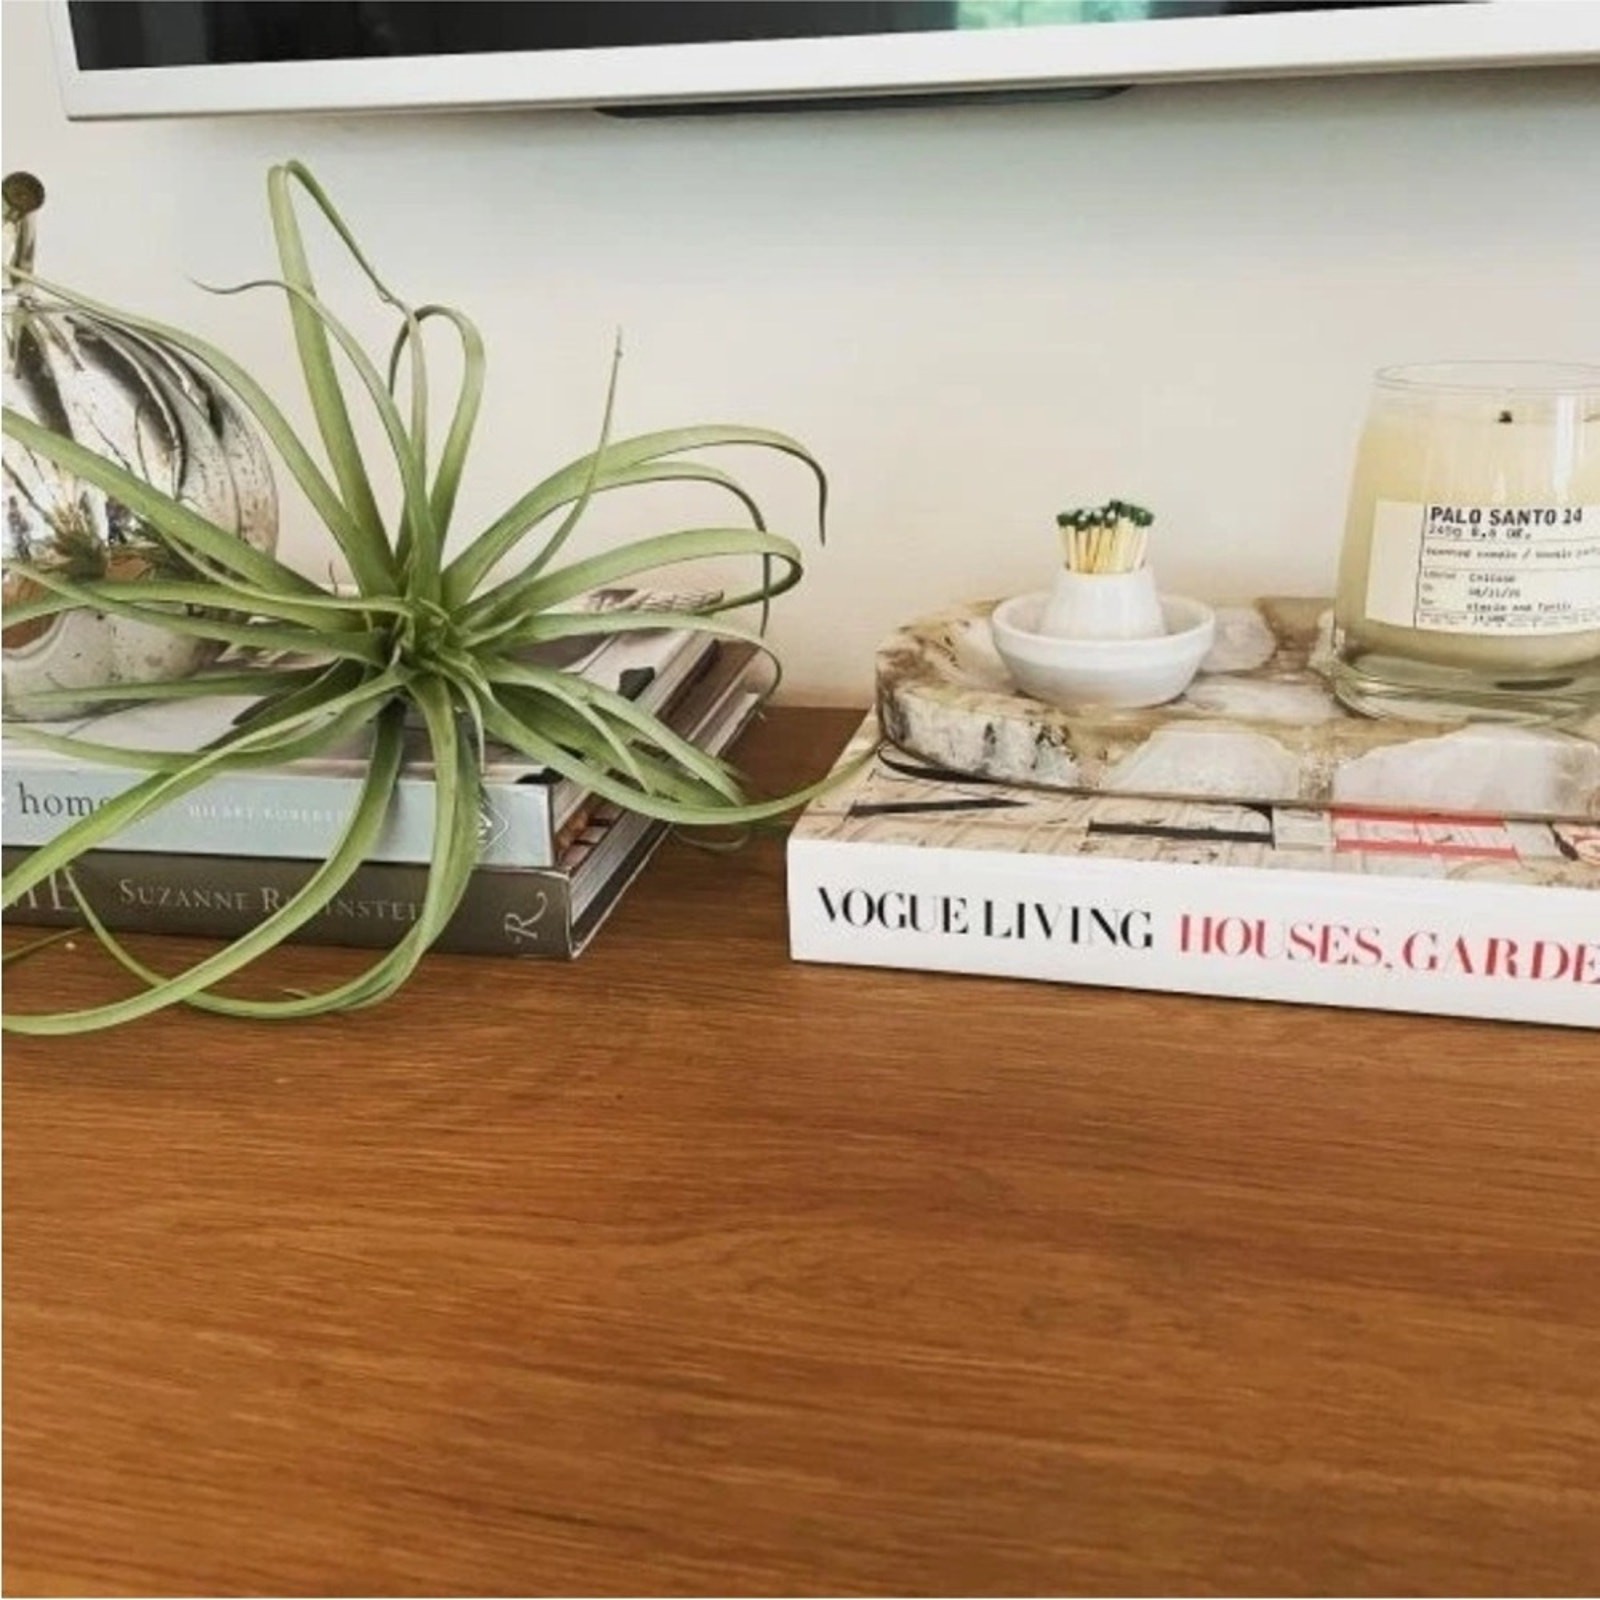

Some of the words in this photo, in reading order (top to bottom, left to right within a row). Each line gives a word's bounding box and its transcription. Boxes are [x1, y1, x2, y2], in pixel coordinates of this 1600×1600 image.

[1430, 507, 1482, 524] PALO
[1488, 508, 1557, 526] SANTO
[118, 878, 248, 911] SUZANNE
[260, 886, 422, 921] RINSTEI
[818, 886, 969, 933] VOGUE
[983, 900, 1153, 949] LIVING
